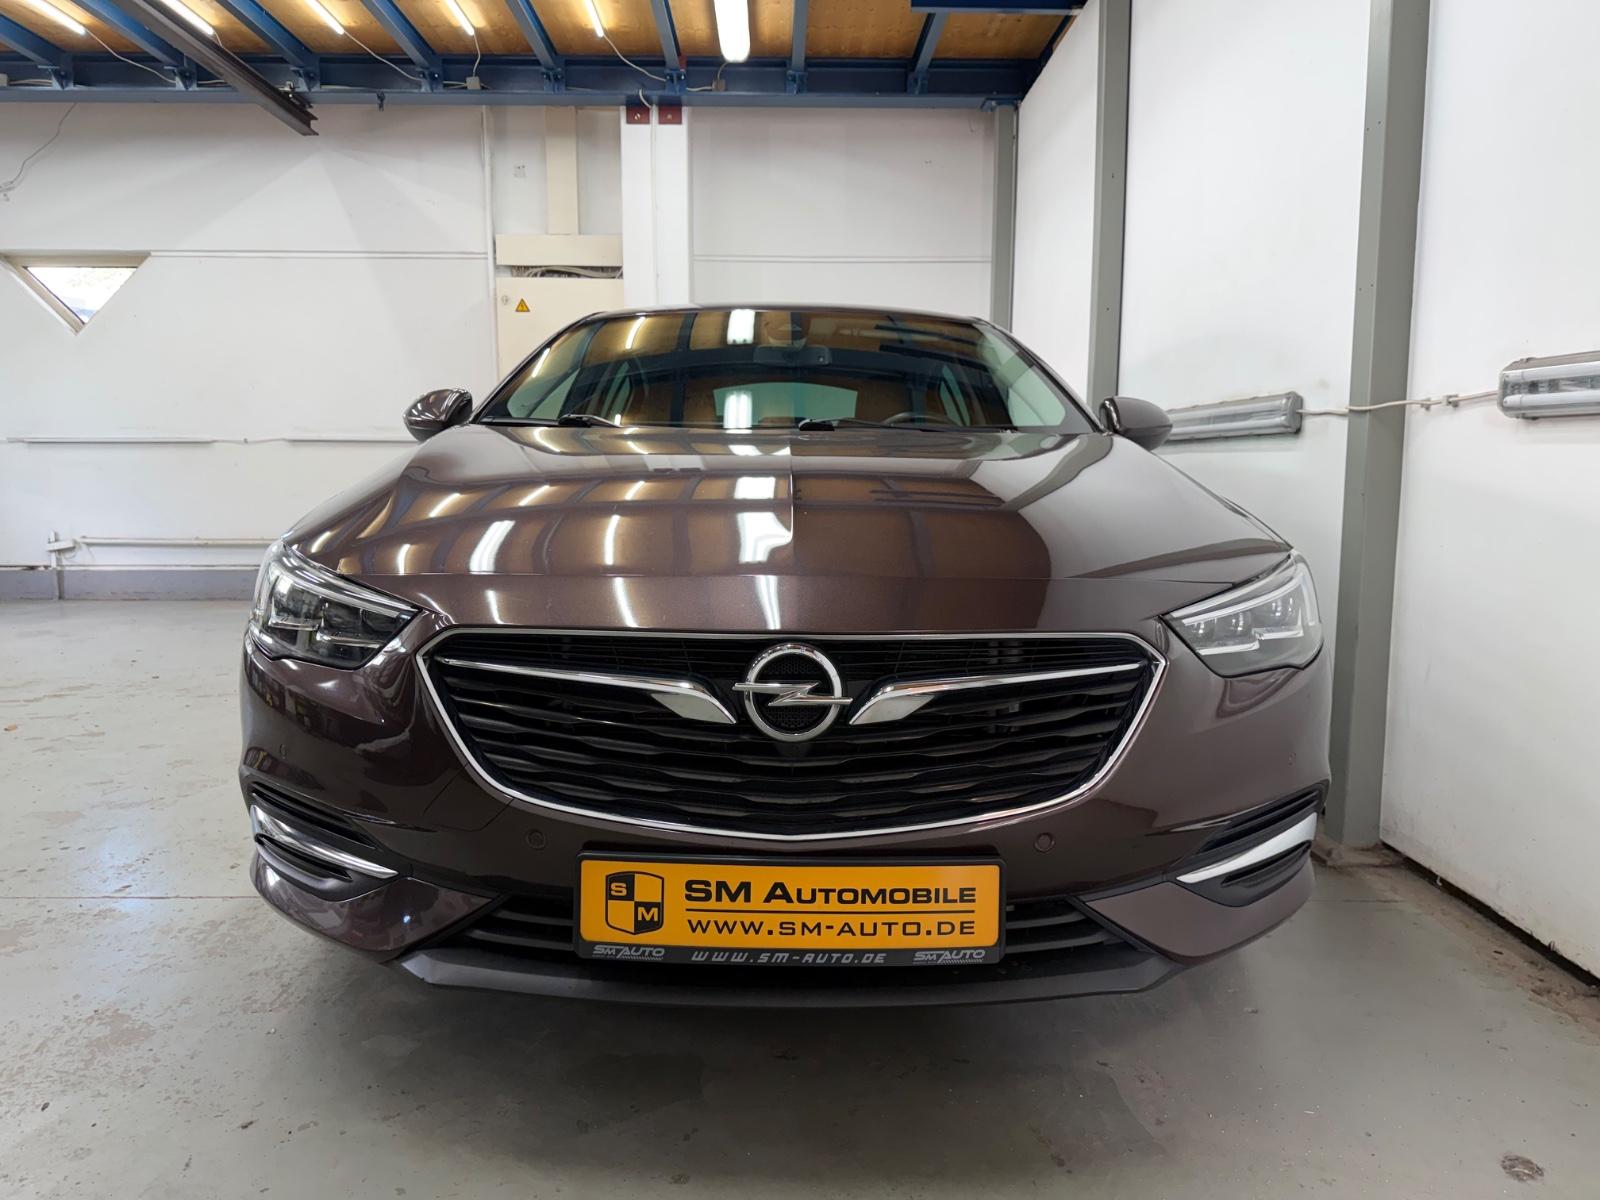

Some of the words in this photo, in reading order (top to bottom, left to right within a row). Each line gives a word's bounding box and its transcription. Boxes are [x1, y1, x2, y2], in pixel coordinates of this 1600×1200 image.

[610, 882, 628, 897] S
[684, 879, 752, 903] SM
[763, 881, 977, 905] AUTOMOBILE
[637, 906, 659, 922] M
[686, 918, 976, 937] WWW.SM-AUTO.DE
